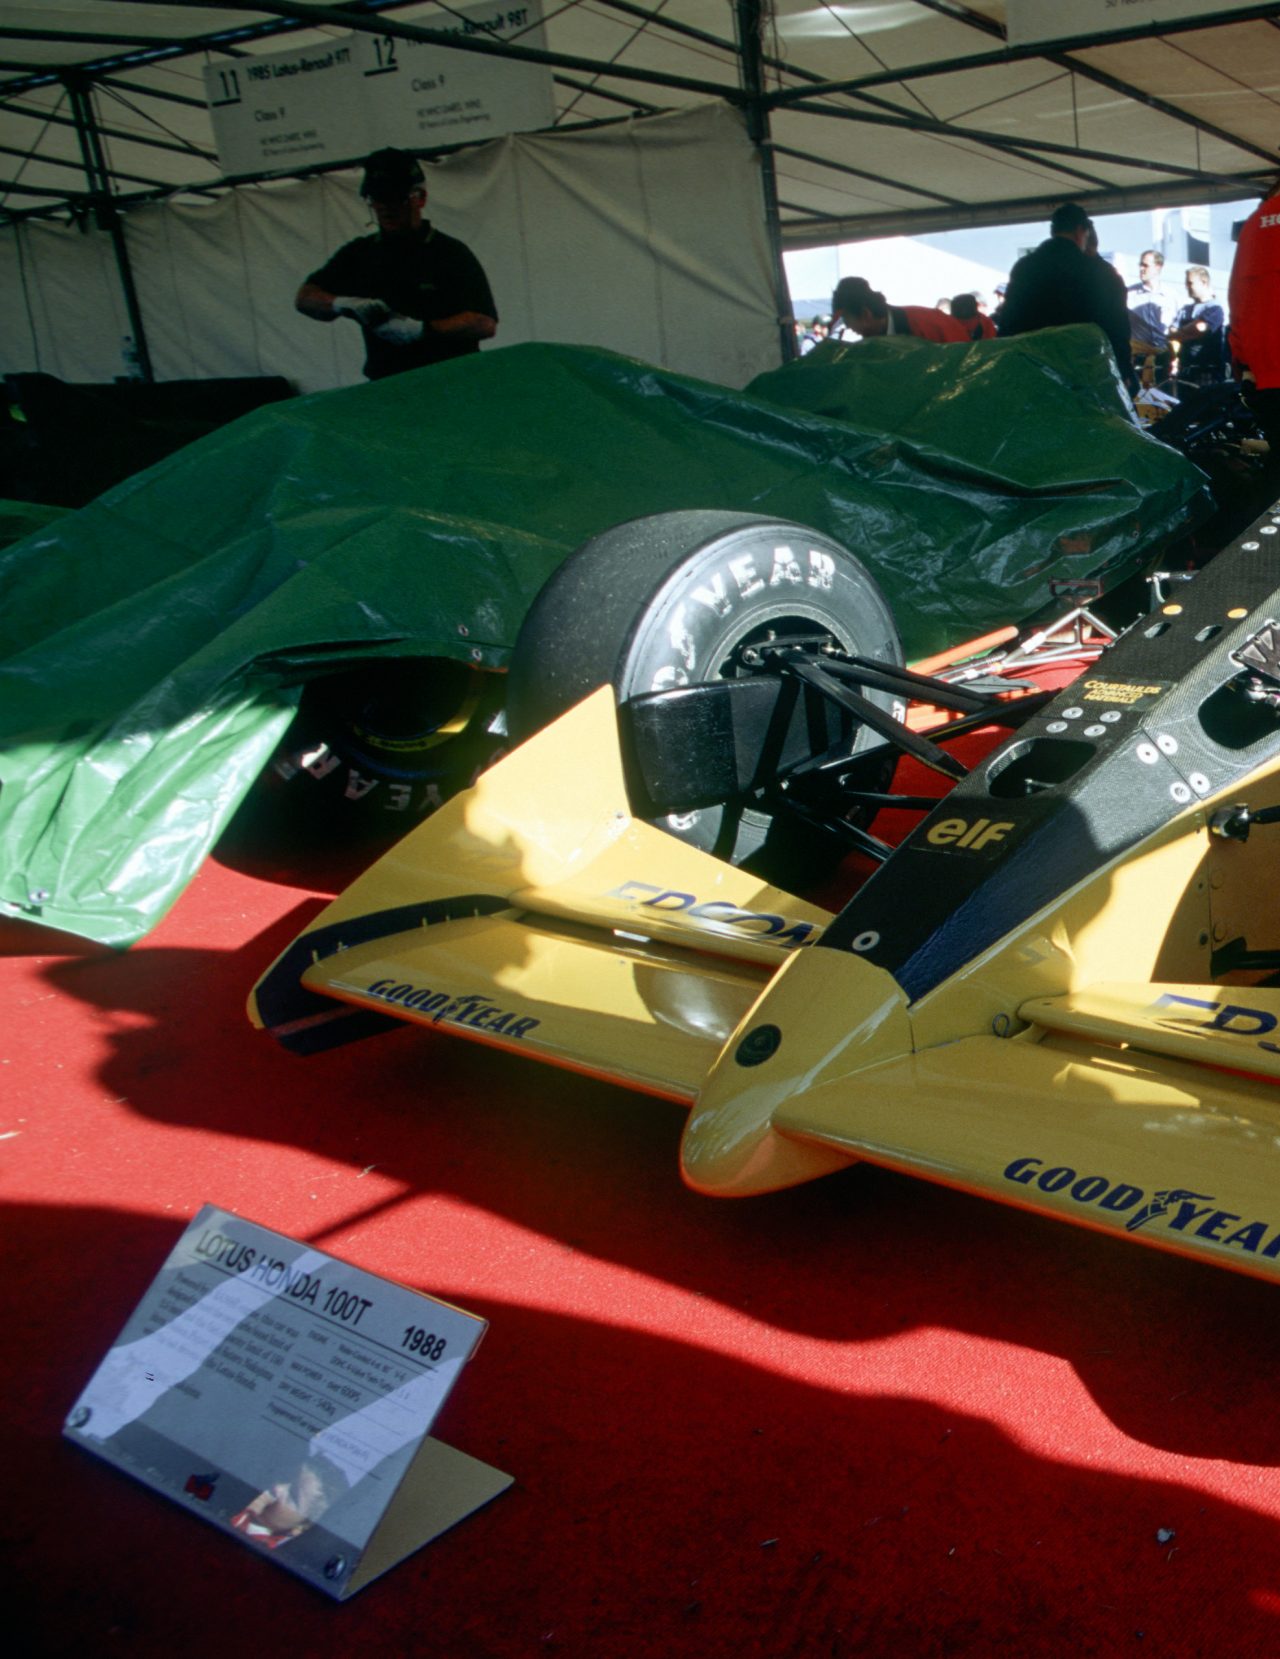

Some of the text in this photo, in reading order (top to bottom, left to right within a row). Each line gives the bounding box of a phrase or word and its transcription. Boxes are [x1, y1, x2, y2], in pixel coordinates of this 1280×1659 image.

[372, 36, 397, 67] 12
[219, 69, 241, 98] 11
[411, 78, 437, 92] Class
[927, 818, 1016, 850] elf
[195, 1230, 256, 1273] LOTUS
[249, 1254, 322, 1306] HONDA
[323, 1286, 373, 1325] 100T
[402, 1325, 446, 1361] 1988
